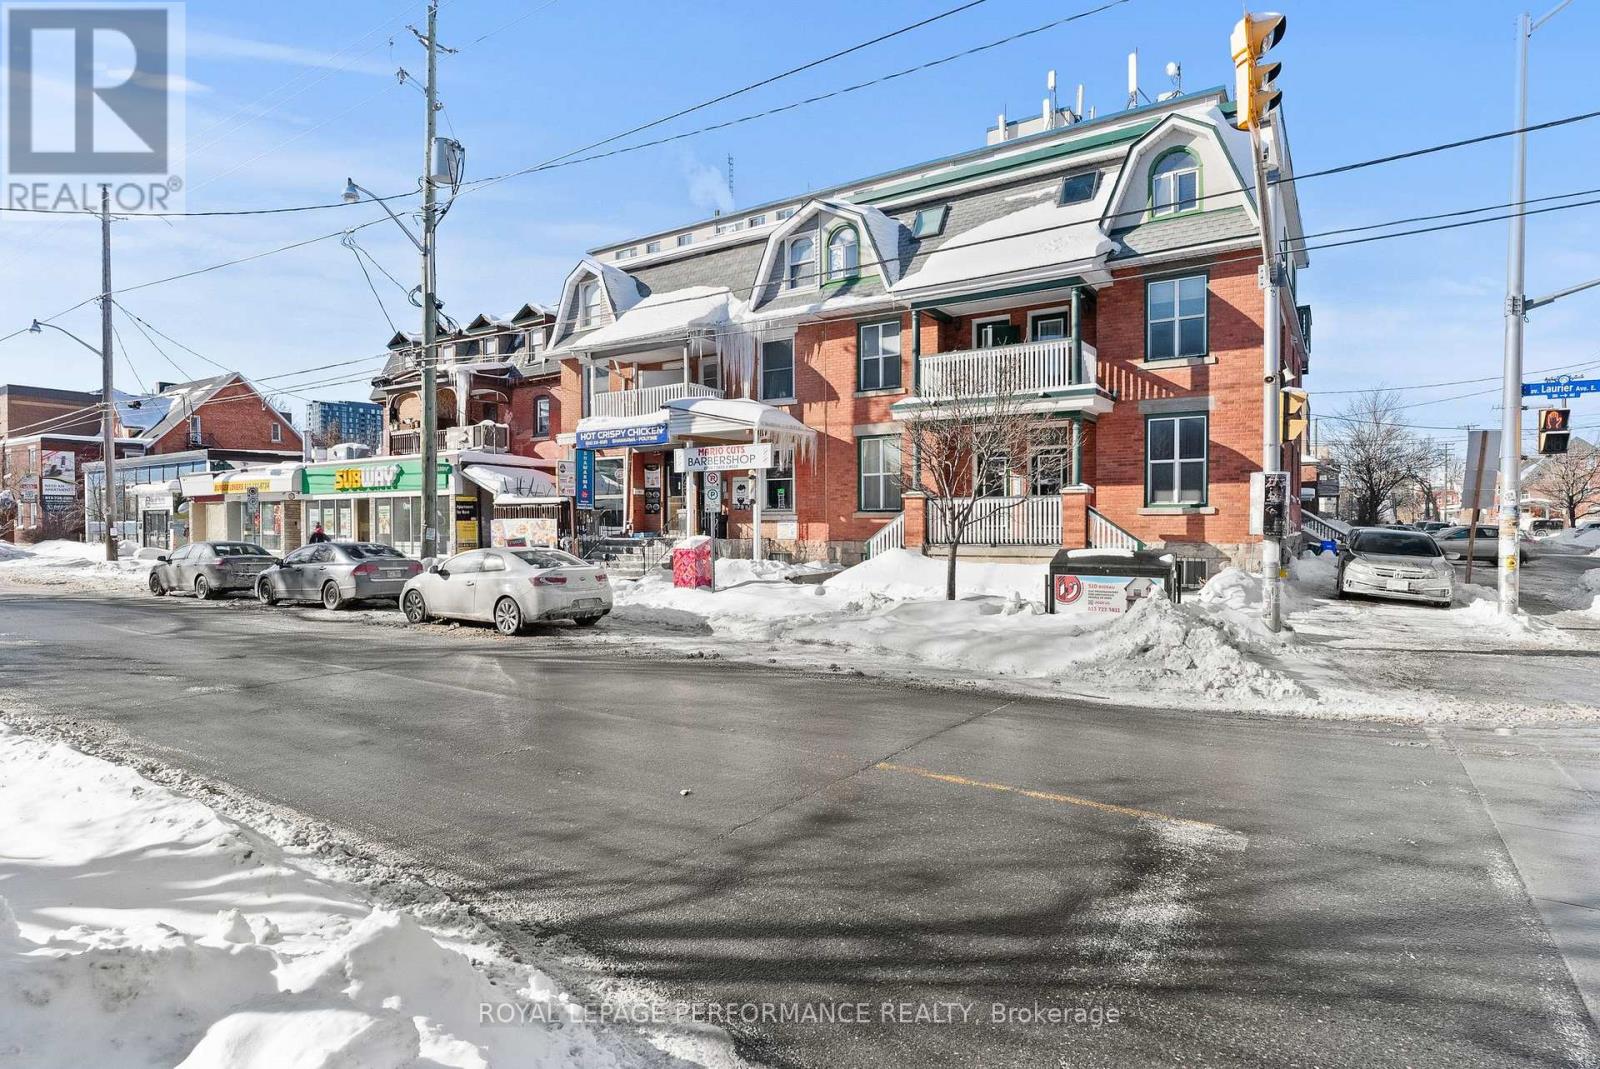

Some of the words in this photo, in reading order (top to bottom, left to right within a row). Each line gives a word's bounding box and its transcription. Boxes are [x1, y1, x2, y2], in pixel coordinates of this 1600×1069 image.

[1541, 384, 1574, 393] Laurier
[580, 432, 596, 440] HOT
[597, 429, 626, 439] CRISPY
[627, 426, 664, 438] CHICKEN
[698, 447, 724, 457] MARIO
[727, 445, 745, 454] CUTS
[688, 454, 756, 467] BARBERSHOP
[335, 464, 402, 490] SUBWAY
